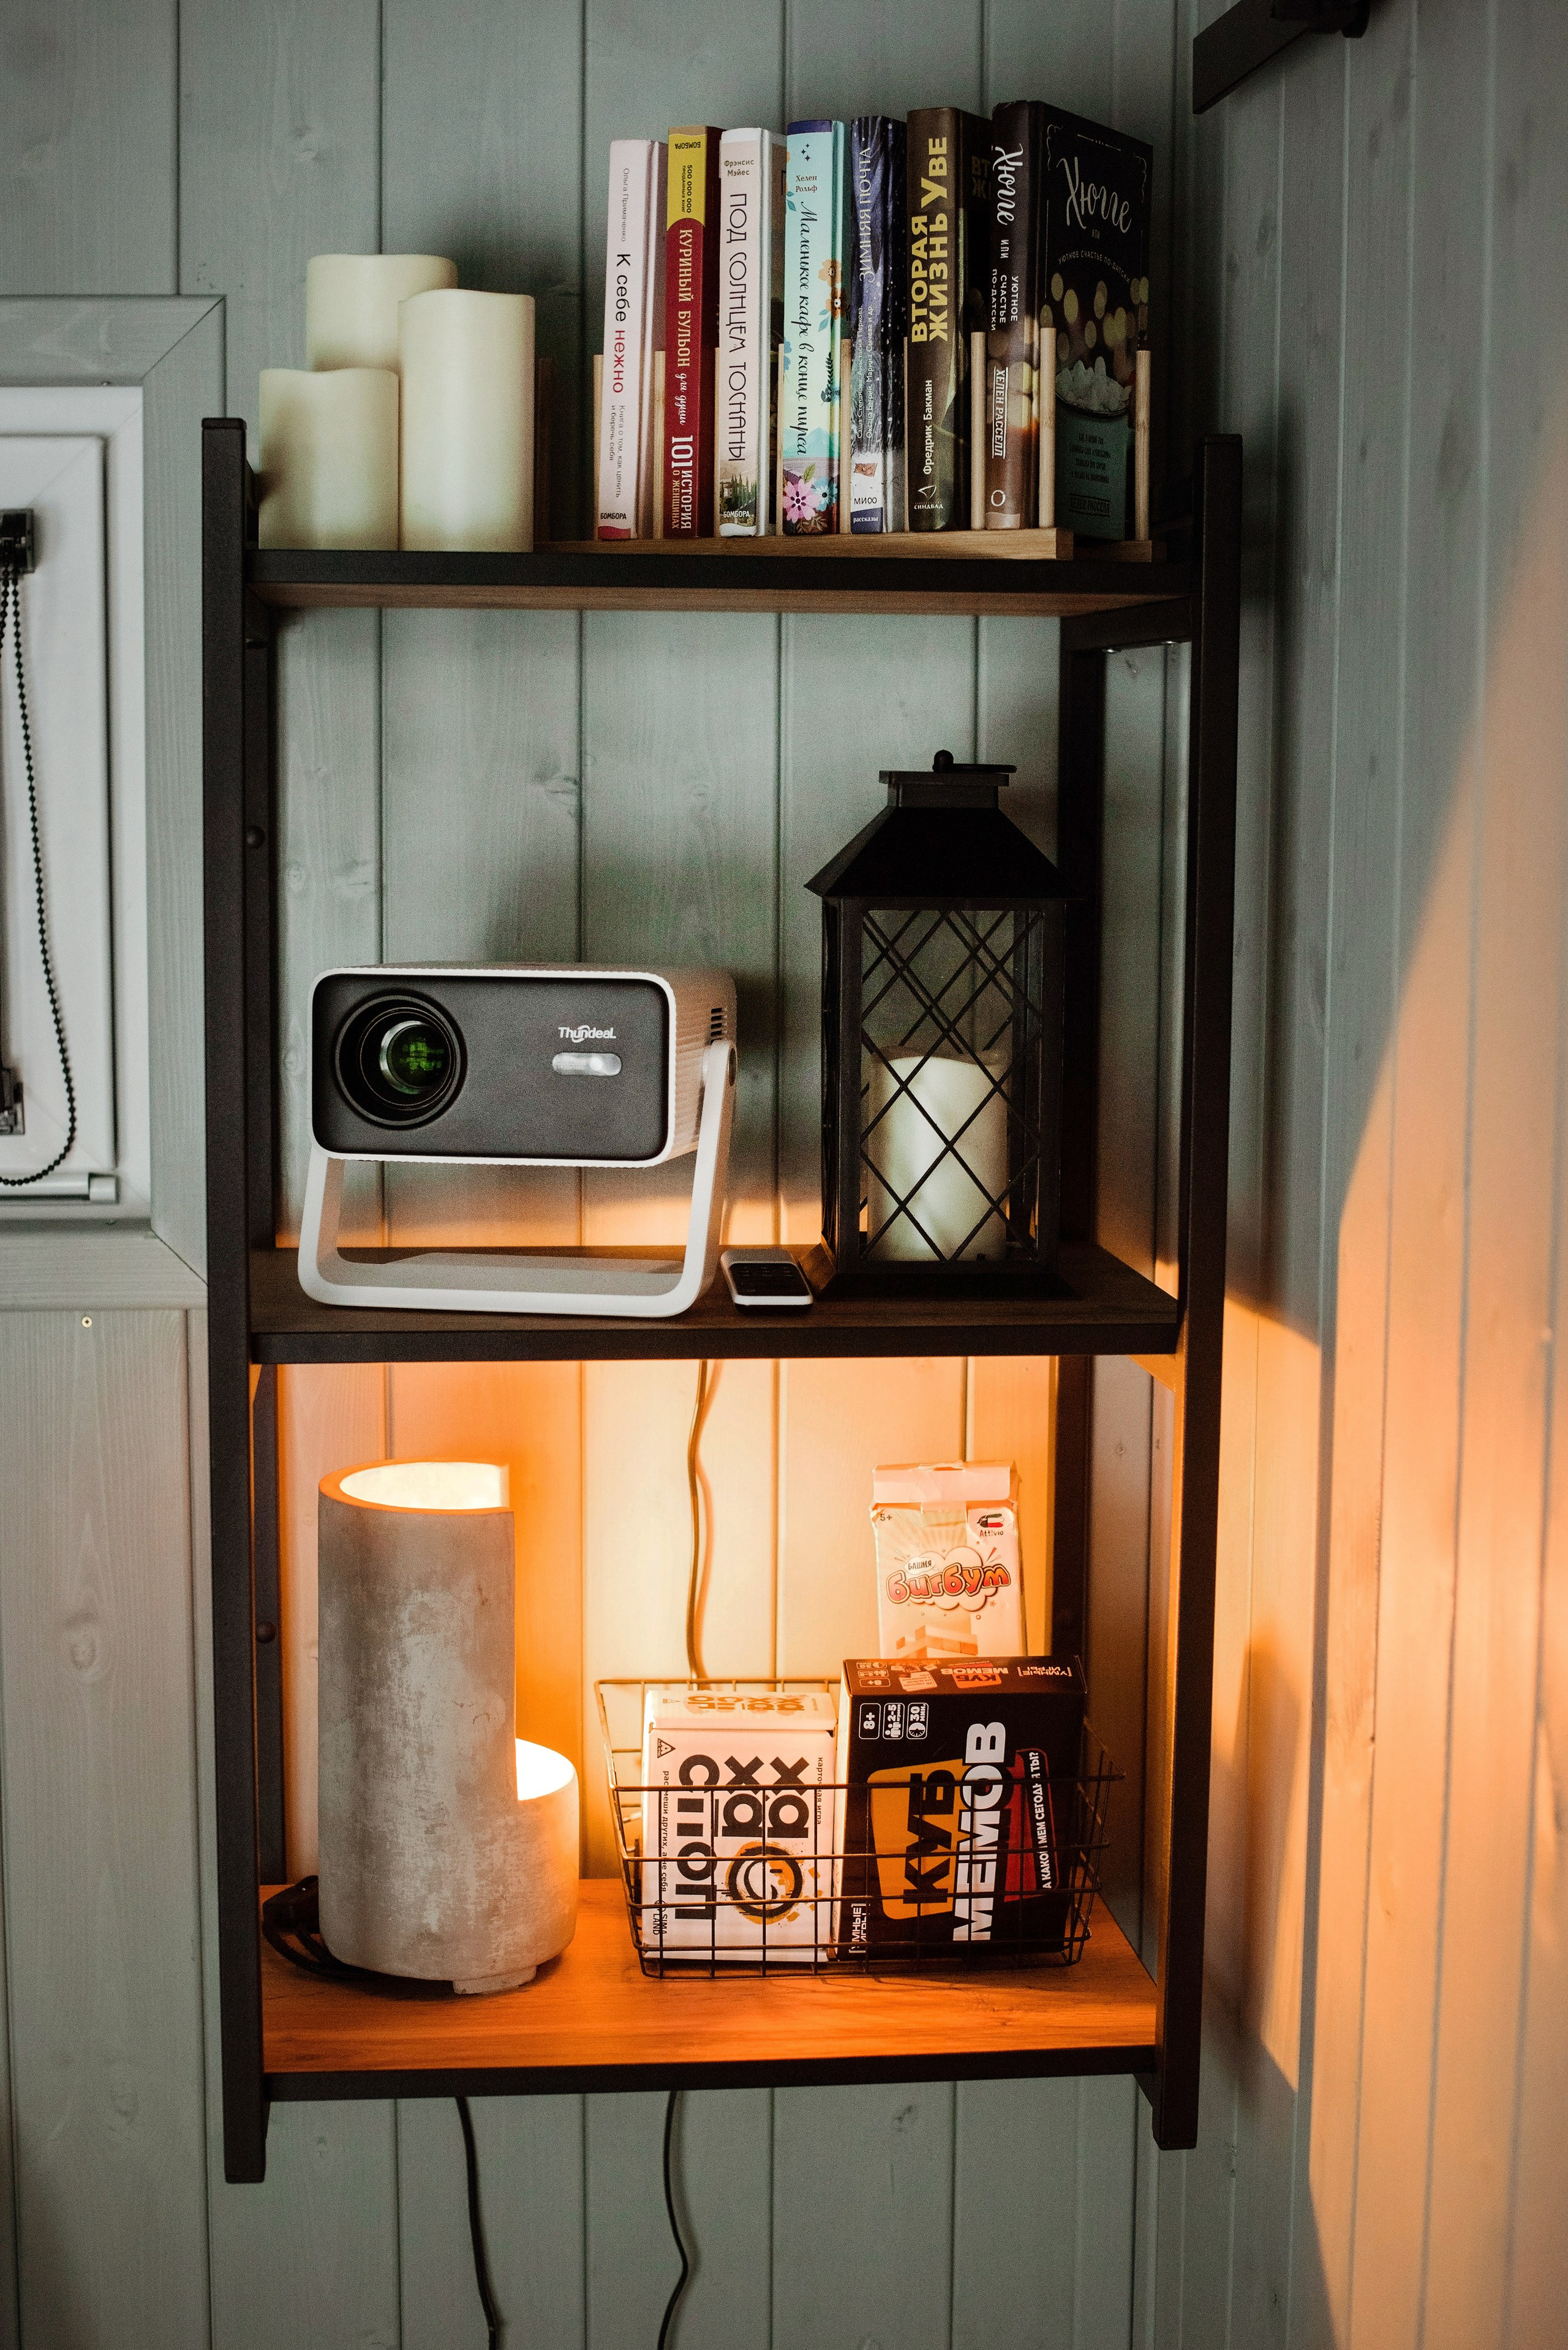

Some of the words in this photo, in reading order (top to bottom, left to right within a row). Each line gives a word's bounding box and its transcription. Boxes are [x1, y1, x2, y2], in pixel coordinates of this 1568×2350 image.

[674, 141, 701, 149] БОМБОРА
[724, 159, 754, 167] Фрэнсис
[727, 168, 750, 177] Мэйес
[859, 147, 871, 206] ПОЧТА
[921, 137, 948, 209] УВЕ
[992, 143, 1023, 225] Хюгге
[1056, 156, 1132, 233] Хюгге
[726, 194, 747, 244] ПОД
[616, 254, 631, 267] К
[679, 229, 694, 303] КУРИНЫЙ
[799, 201, 818, 290] Маленькое
[859, 209, 875, 284] ЗИМНЯЯ
[1058, 250, 1079, 265] УЮТНОЕ
[1080, 250, 1103, 262] СЧАСТЬЕ
[1104, 256, 1131, 284] ПО-ДАТСКИ
[615, 275, 630, 322] себе
[726, 252, 747, 353] СОЛНЦЕМ
[911, 215, 928, 342] ВТОРАЯ
[929, 213, 948, 342] ЖИЗНЬ
[1011, 276, 1019, 322] УЮТНОЕ
[677, 311, 691, 367] БУЛЬОН
[791, 295, 812, 337] кафе
[613, 330, 625, 393] нежно
[676, 373, 687, 392] для
[796, 355, 809, 401] конце
[995, 369, 1006, 404] ХЕЛЕН
[674, 395, 687, 425] души
[728, 361, 746, 461] ТОСКАНЫ
[923, 380, 933, 421] Бакман
[671, 434, 693, 469] 101
[790, 406, 808, 456] пирса
[923, 425, 935, 475] Фредрик
[994, 406, 1004, 456] РАССЕЛЛ
[671, 478, 680, 529] ЖЕНЩИНАХ
[680, 470, 693, 529] ИСТОРИЯ
[886, 1562, 1011, 1604] бигбум
[908, 1560, 932, 1570] БАШНЯ
[863, 1712, 875, 1730] 8+
[887, 1704, 897, 1721] 2-5
[910, 1706, 920, 1721] 30
[1029, 1751, 1040, 1772] ТЫ?
[722, 1756, 765, 1838] ха
[767, 1756, 810, 1838] ха
[661, 1816, 669, 1849] других,
[903, 1768, 956, 1905] КУБ
[952, 1721, 1006, 1941] МЕМОВ
[1036, 1821, 1047, 1844] МЕМ
